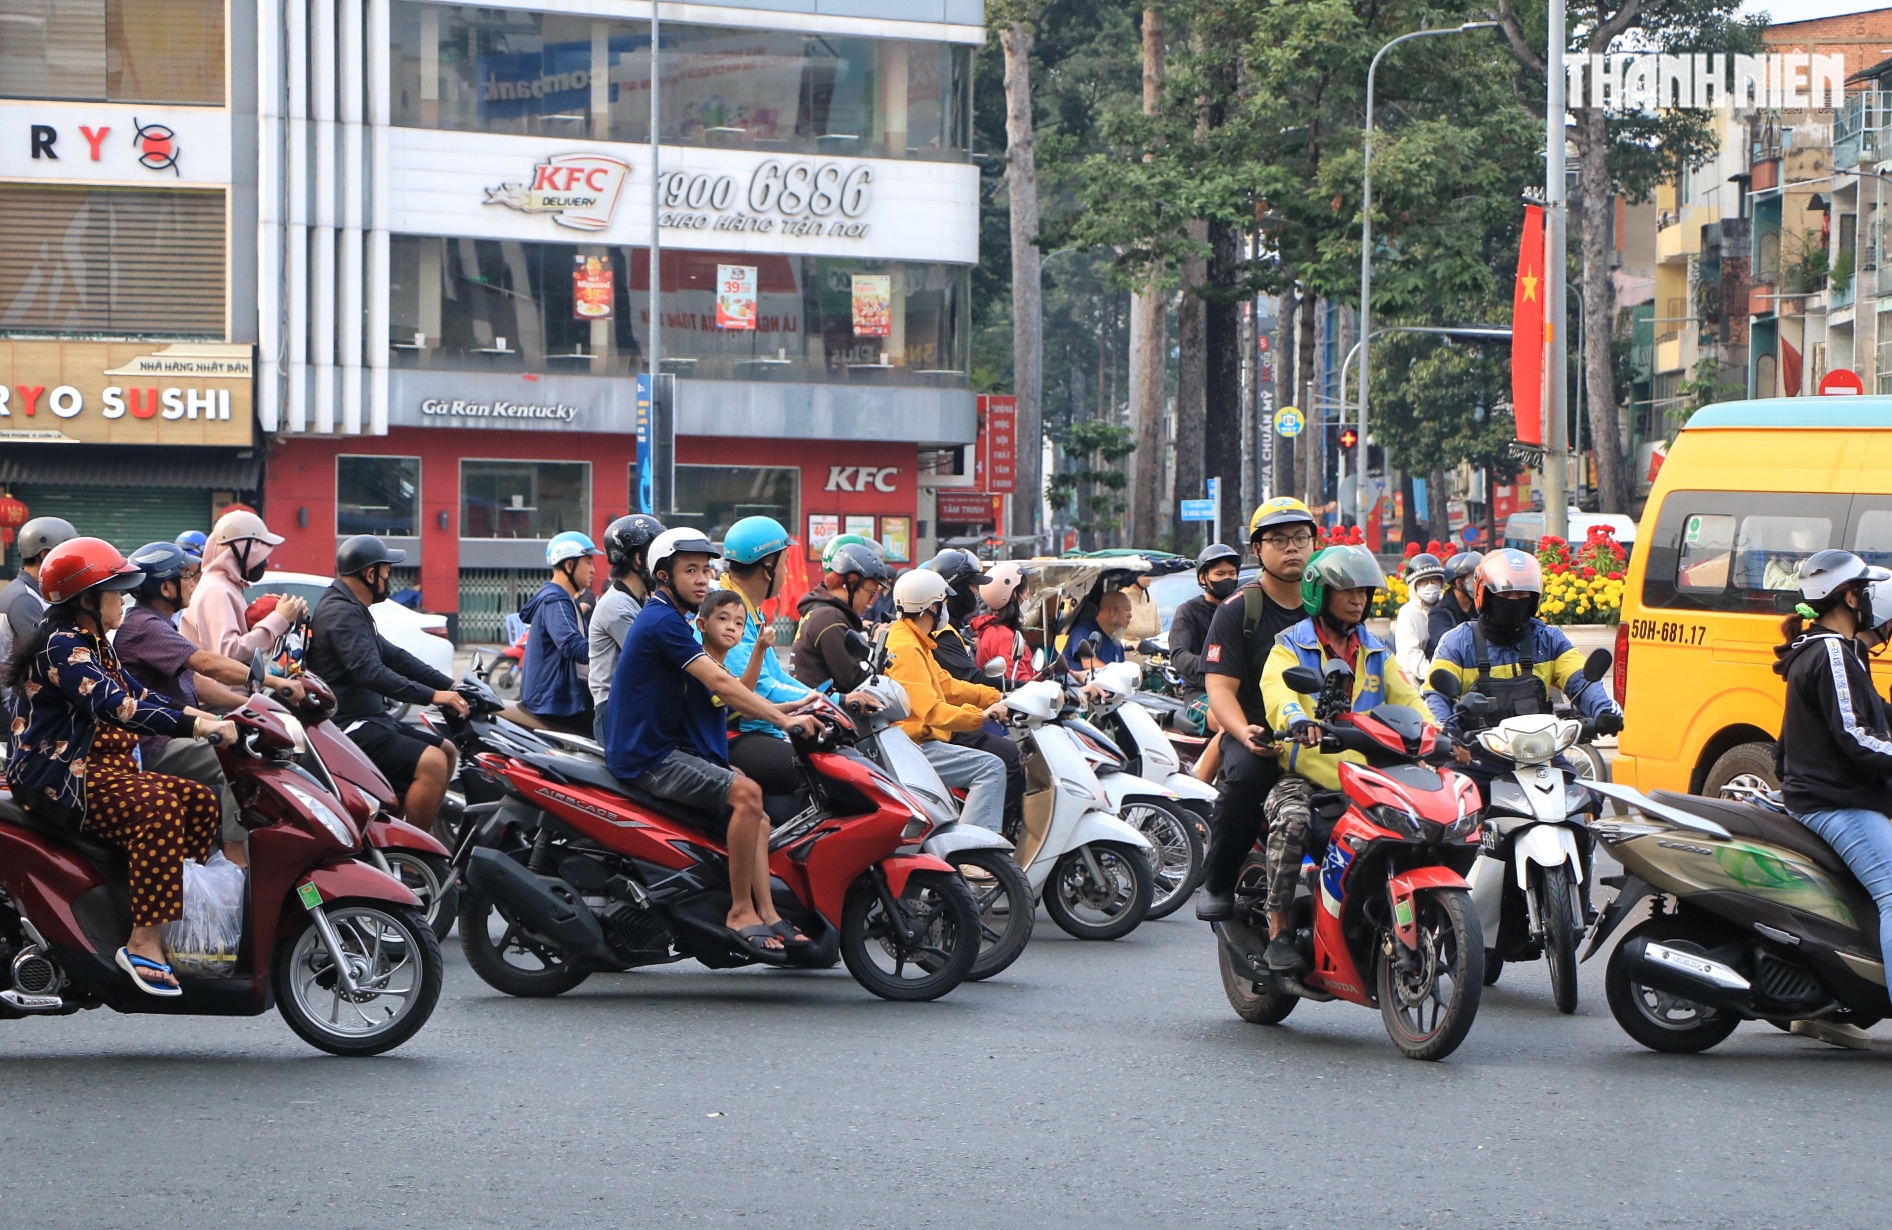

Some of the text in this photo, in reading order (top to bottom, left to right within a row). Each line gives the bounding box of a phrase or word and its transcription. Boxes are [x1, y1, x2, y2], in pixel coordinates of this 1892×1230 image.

[533, 166, 608, 193] KFC
[658, 159, 875, 218] 1900 6886
[542, 196, 597, 207] DELIVERY
[724, 281, 740, 294] 39
[140, 359, 163, 371] NHÀ
[165, 360, 194, 372] HÀNG
[101, 386, 231, 421] SUSHI
[421, 399, 579, 423] Gà Rán Kentucky
[824, 465, 899, 493] KFC
[813, 525, 826, 537] 40
[1631, 619, 1707, 647] 50H-681.17
[1657, 840, 1713, 855] LEAD
[1323, 978, 1360, 994] HONDA
